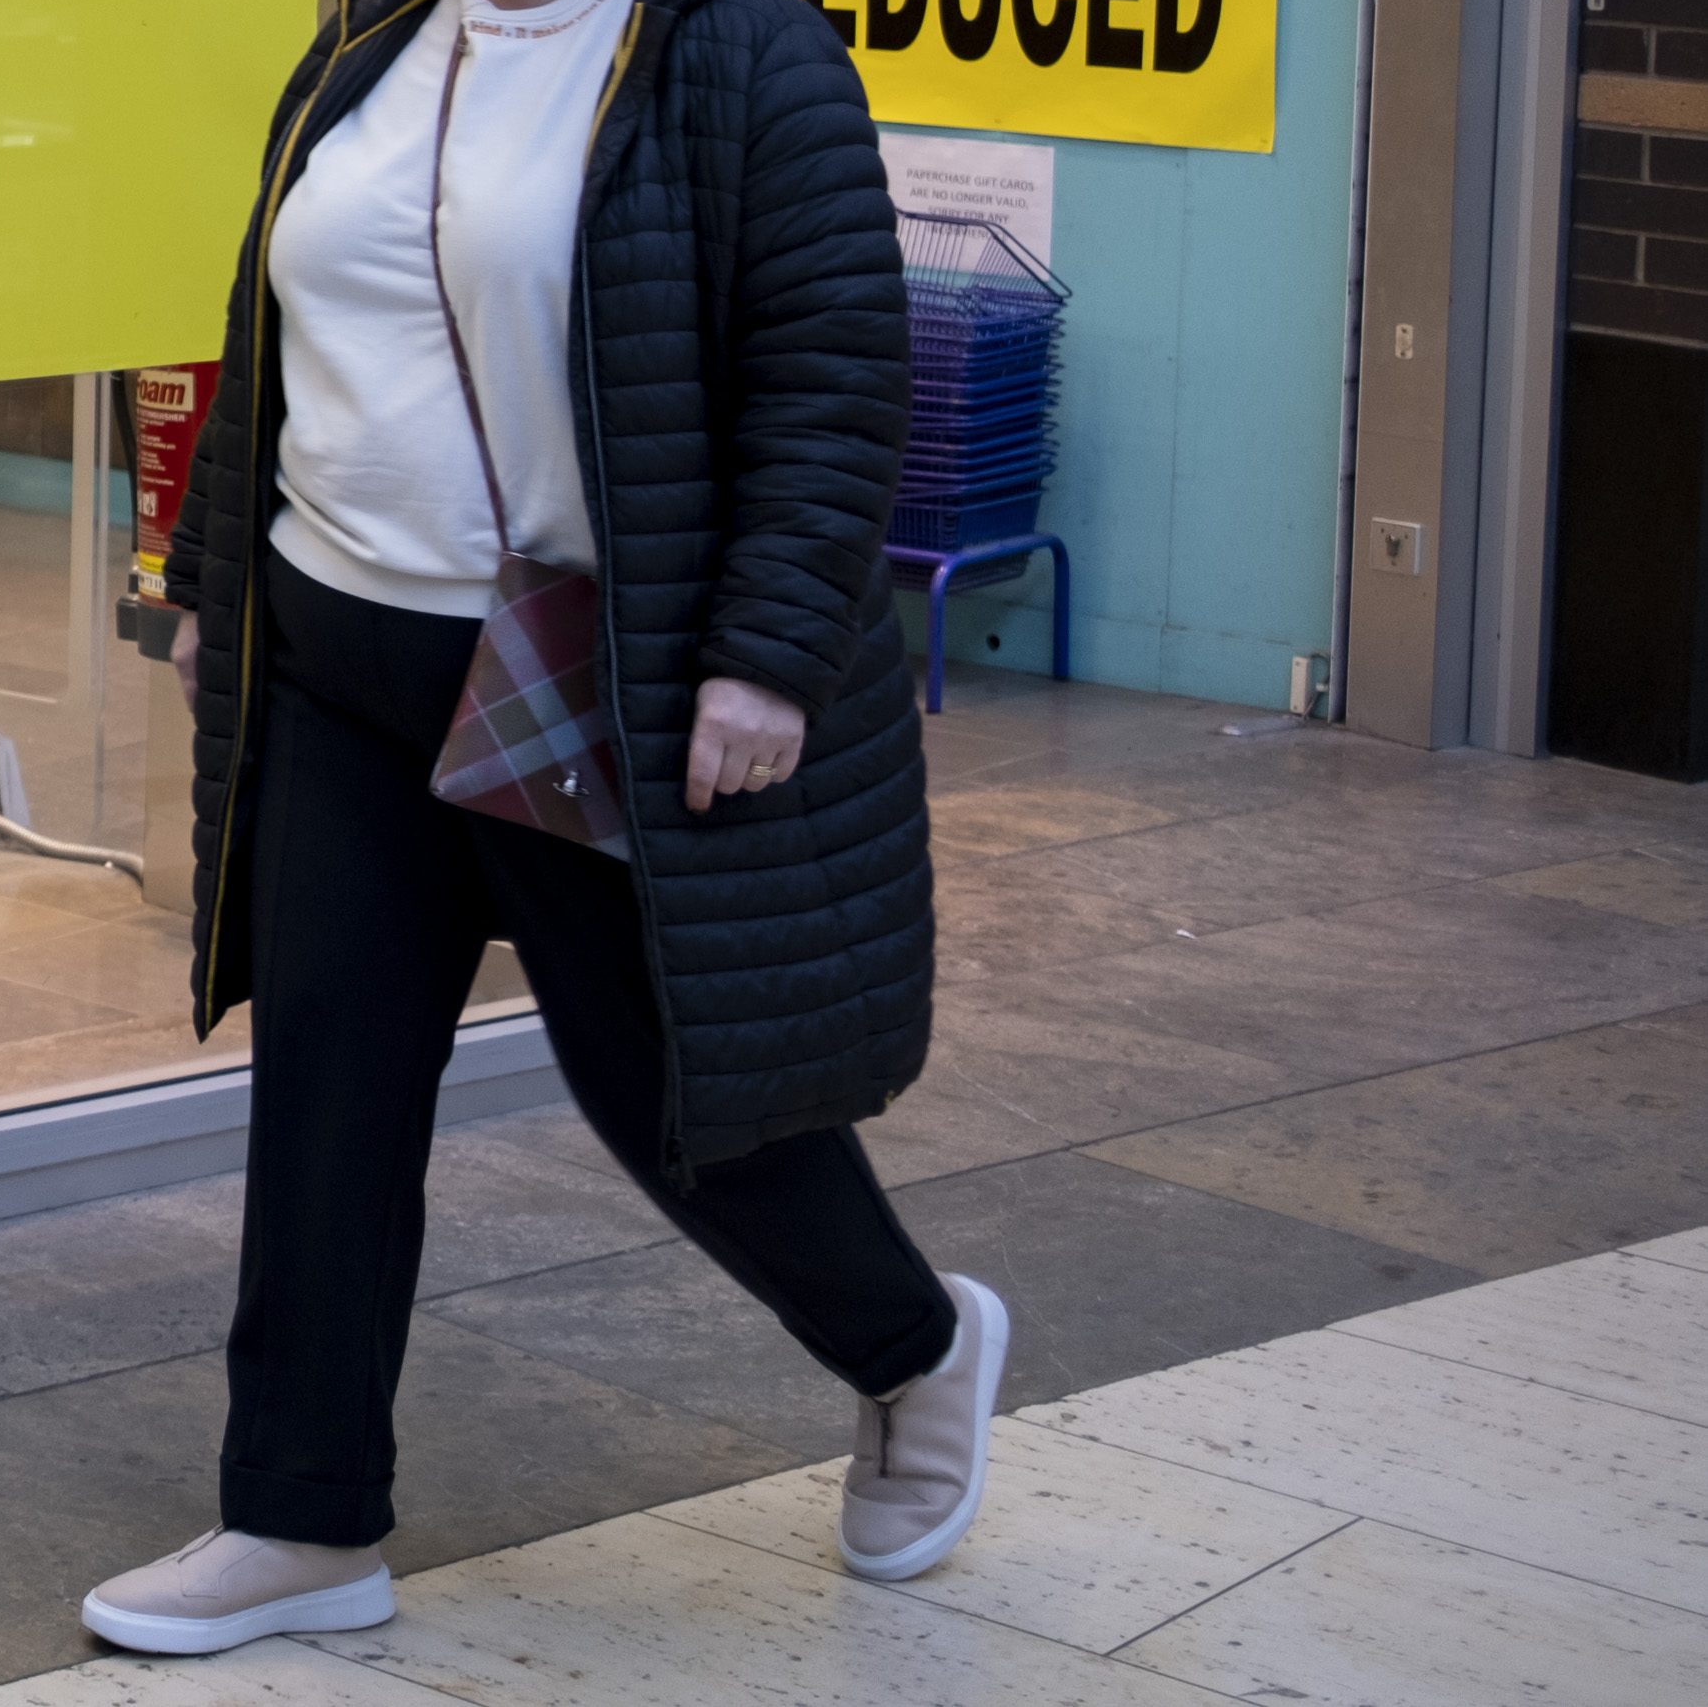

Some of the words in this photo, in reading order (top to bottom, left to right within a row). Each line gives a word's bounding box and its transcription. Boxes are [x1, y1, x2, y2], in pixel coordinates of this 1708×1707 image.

[906, 168, 971, 185] PAPERCHASE
[973, 175, 997, 188] GIFT
[932, 188, 948, 201] NO
[950, 190, 993, 205] LONGER
[138, 376, 186, 406] oam
